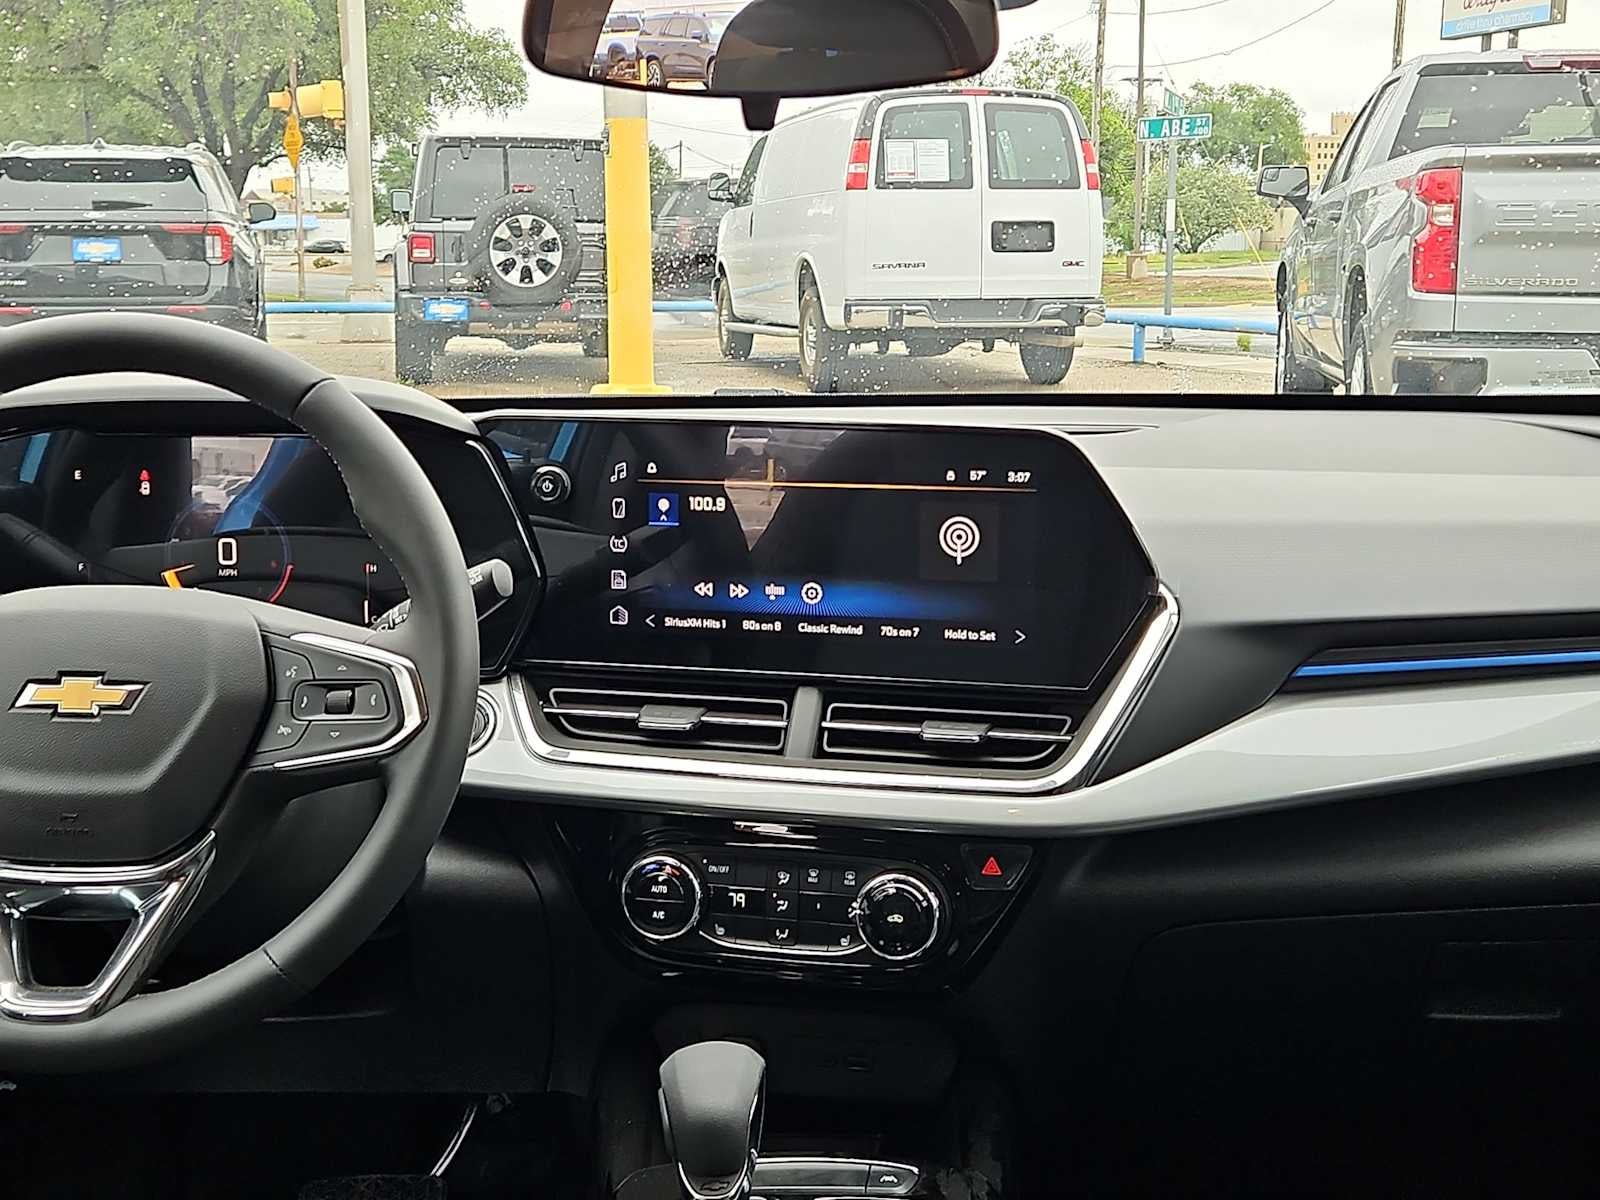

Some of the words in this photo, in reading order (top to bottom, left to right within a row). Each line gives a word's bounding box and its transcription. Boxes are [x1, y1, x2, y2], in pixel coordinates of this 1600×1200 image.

[1140, 120, 1155, 138] N.
[1161, 118, 1190, 137] ABE
[872, 262, 926, 270] SAVANA
[1463, 277, 1579, 287] SILVERADO
[74, 469, 82, 480] E
[1007, 471, 1031, 483] 3:07
[688, 496, 726, 512] 100.9
[217, 537, 238, 566] 0
[78, 562, 86, 572] F
[369, 564, 377, 573] H
[218, 569, 238, 577] MPH
[664, 617, 702, 628] SiriusXM
[702, 618, 721, 628] Hits
[761, 622, 774, 631] on
[798, 622, 829, 634] Classic
[829, 623, 863, 636] Rewind
[880, 625, 899, 637] 70s
[899, 628, 912, 637] on
[912, 627, 920, 638] 7
[944, 628, 968, 640] Hold
[968, 631, 979, 640] to
[979, 630, 997, 642] Set
[708, 865, 730, 873] ON/OFF
[651, 885, 668, 893] AUTO
[727, 892, 746, 908] 79
[652, 911, 665, 919] A/C
